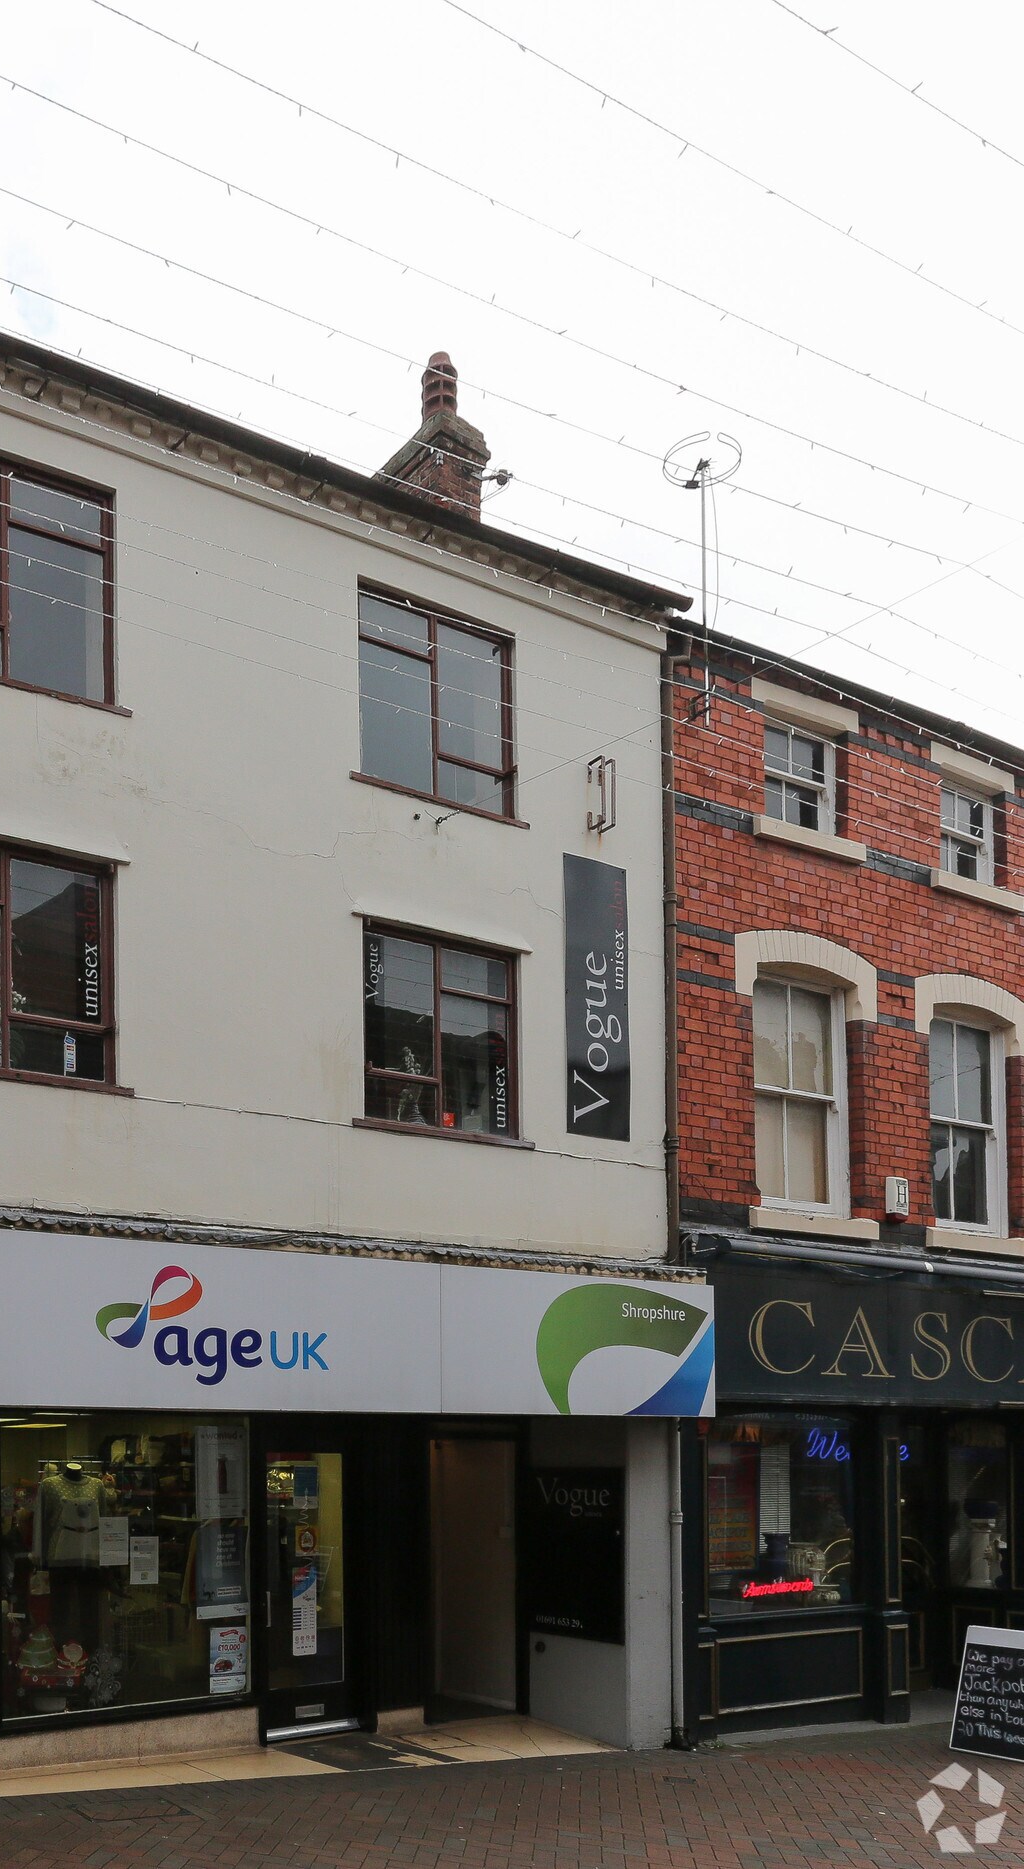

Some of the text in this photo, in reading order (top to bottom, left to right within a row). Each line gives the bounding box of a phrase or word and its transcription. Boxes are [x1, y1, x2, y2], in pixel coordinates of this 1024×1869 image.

[78, 943, 98, 1017] unisex
[366, 943, 383, 999] Vogue
[610, 929, 624, 991] unisex
[573, 950, 622, 1123] Vogue
[491, 1065, 506, 1129] unisex
[621, 1302, 688, 1323] Shropshire
[153, 1324, 329, 1386] age UK
[748, 1299, 1024, 1384] CASC
[536, 1477, 610, 1517] Vogue
[964, 1663, 996, 1674] more
[967, 1649, 988, 1663] We
[991, 1655, 1014, 1671] pay
[959, 1690, 985, 1703] than
[960, 1706, 985, 1718] else
[991, 1709, 1002, 1721] in
[975, 1722, 1002, 1739] This
